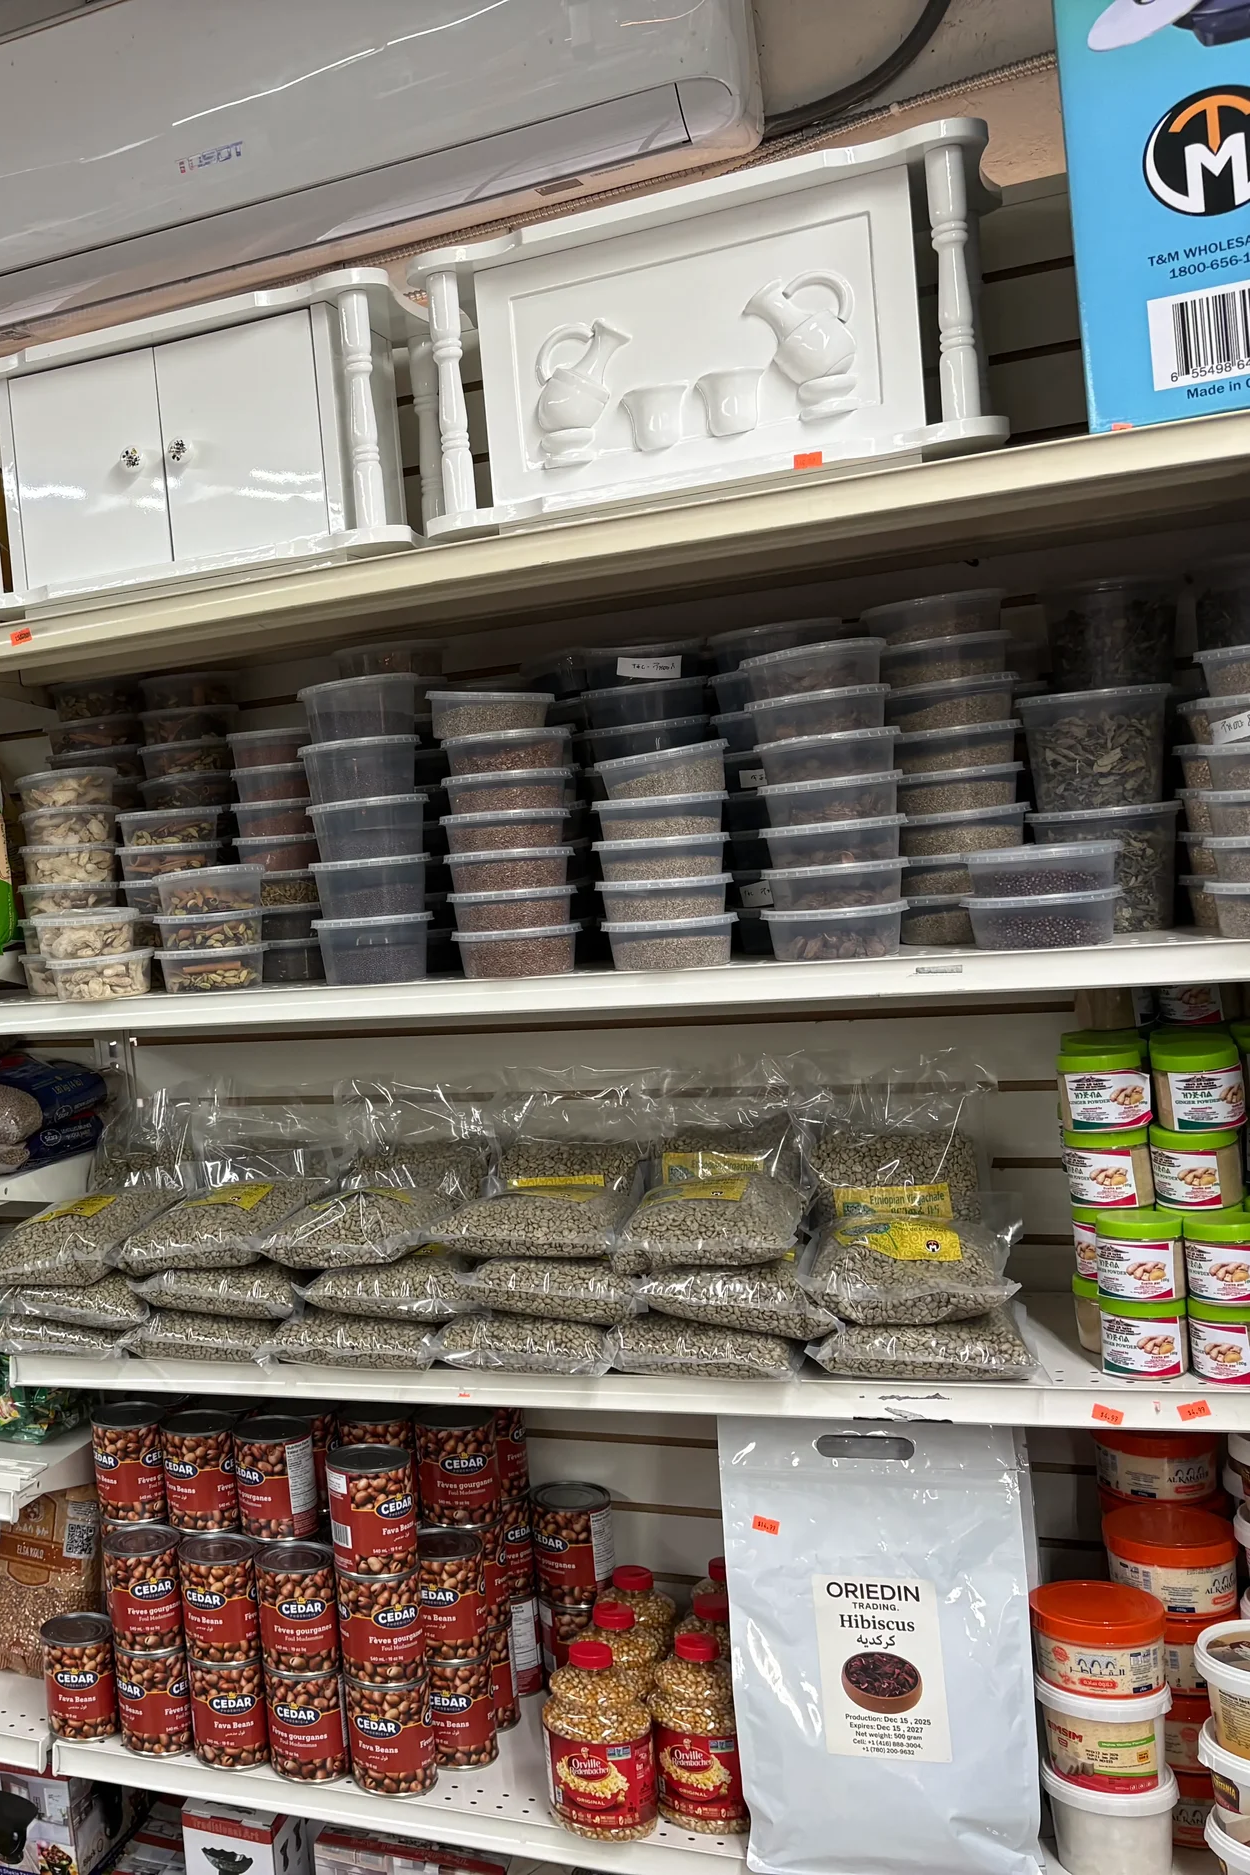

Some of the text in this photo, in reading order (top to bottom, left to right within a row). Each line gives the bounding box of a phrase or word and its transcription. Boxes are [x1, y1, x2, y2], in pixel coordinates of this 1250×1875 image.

[1148, 234, 1250, 267] T&M WHOLESA
[1168, 252, 1250, 280] 1800-656-1
[1170, 371, 1179, 383] 6
[1191, 362, 1232, 379] 55498
[1186, 379, 1241, 400] Made in
[870, 1194, 905, 1207] Ethiopian
[165, 1460, 193, 1476] CEDAR
[444, 1456, 484, 1470] CEDAR
[235, 1466, 260, 1484] CEDAR
[177, 1484, 196, 1495] Beans
[437, 1477, 494, 1490] Fèves gourganes
[380, 1498, 412, 1515] CEDAR
[382, 1525, 399, 1536] Fava
[507, 1526, 530, 1541] CEDA
[534, 1531, 564, 1551] CEDAR
[16, 1545, 44, 1560] ELSA KOLO
[134, 1580, 172, 1596] CEDAR
[826, 1581, 921, 1603] ORIEDIN
[186, 1591, 221, 1606] CEDAR
[421, 1590, 454, 1602] EDAR
[127, 1601, 181, 1616] Fèves gourganes
[281, 1602, 321, 1615] CEDAR
[852, 1602, 900, 1612] TRADING.
[188, 1612, 223, 1625] Fava Beans
[378, 1608, 416, 1624] CEDAR
[433, 1613, 457, 1622] Beans
[839, 1613, 915, 1632] Hibiscus
[274, 1624, 333, 1636] Fèves gourganes
[368, 1628, 423, 1645] Fèves gourganes
[856, 1634, 896, 1649] كركديه
[57, 1673, 94, 1684] CEDAR
[117, 1682, 141, 1697] CEDAR
[58, 1694, 97, 1703] Fava Beans
[212, 1697, 252, 1709] CEDAR
[429, 1695, 467, 1708] CEDAR
[276, 1707, 315, 1721] CEDAR
[845, 1713, 883, 1723] Production:
[914, 1718, 931, 1726] 2025
[213, 1720, 254, 1729] Fava Beans
[356, 1717, 396, 1732] CEDAR
[849, 1722, 876, 1731] Expires:
[906, 1726, 924, 1734] 2027
[271, 1726, 328, 1742] Fèves gourganes
[868, 1732, 893, 1740] weight:
[358, 1740, 398, 1754] Fava Beans
[674, 1749, 703, 1761] Orville
[571, 1757, 601, 1769] Orville
[678, 1787, 708, 1798] ORIGINAL
[576, 1796, 606, 1806] ORIGINAL
[243, 1829, 260, 1841] Art
